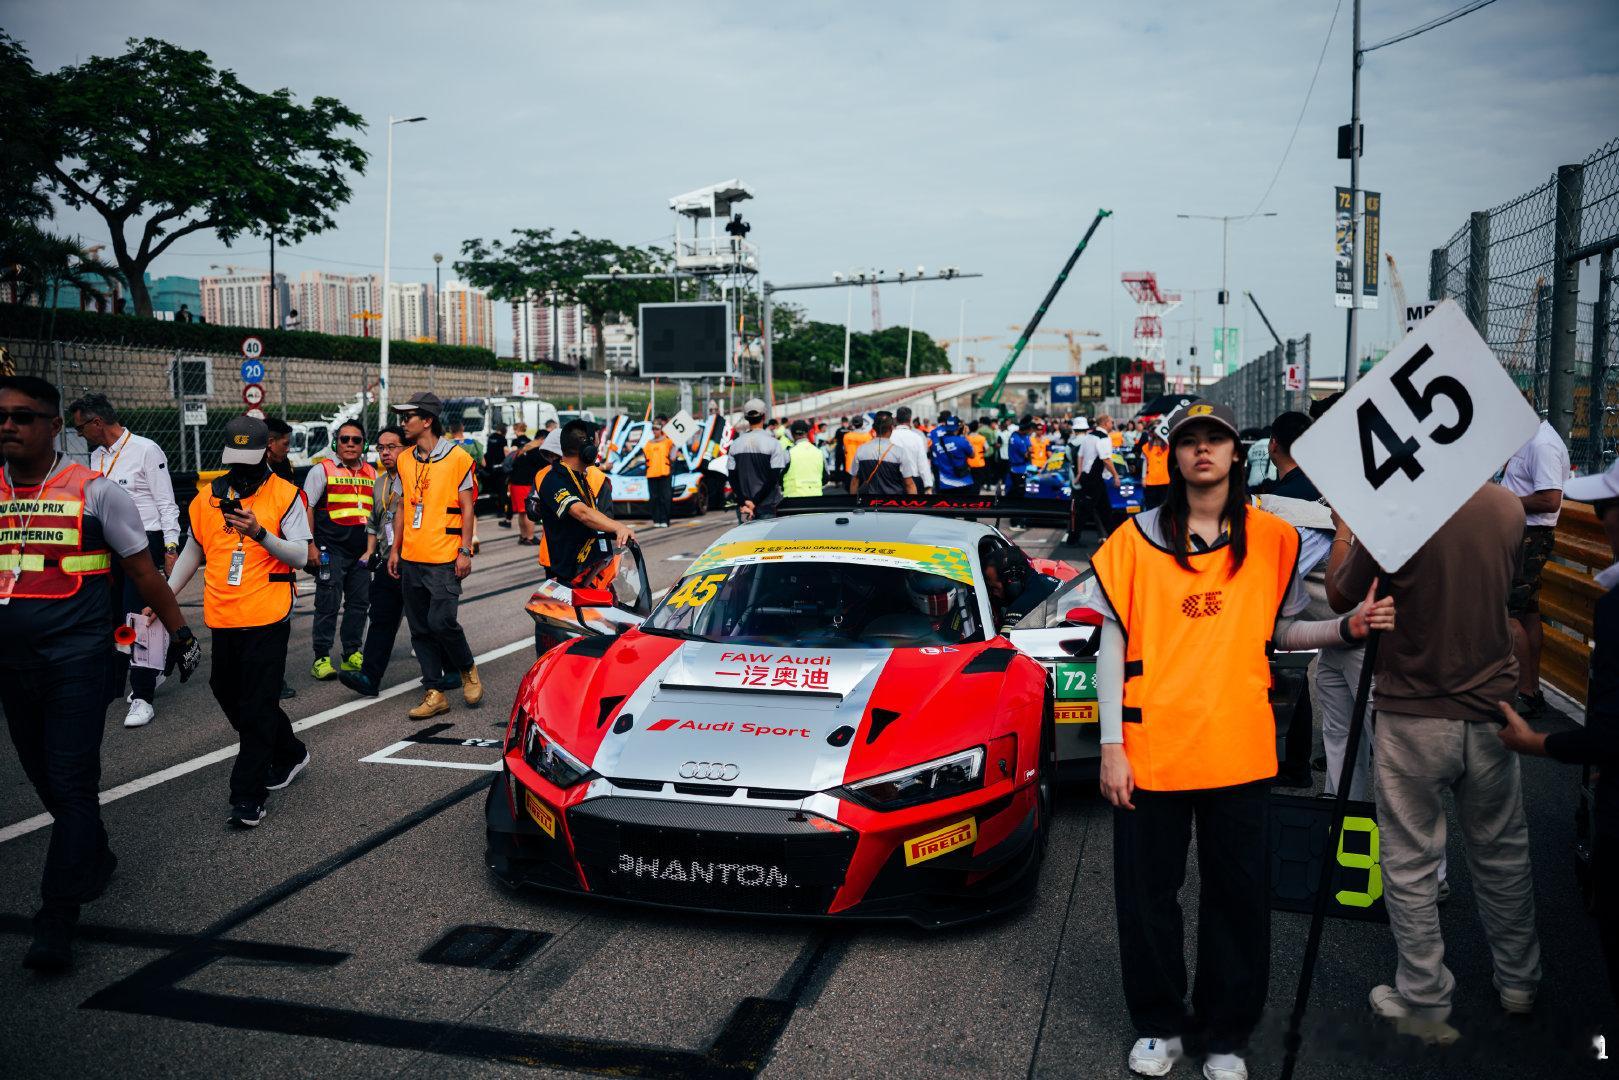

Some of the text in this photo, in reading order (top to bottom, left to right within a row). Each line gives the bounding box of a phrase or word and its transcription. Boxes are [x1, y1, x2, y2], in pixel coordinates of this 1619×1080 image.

[1339, 192, 1351, 208] 72
[246, 343, 259, 353] 40
[245, 365, 261, 378] 20
[1356, 343, 1474, 490] 45
[672, 419, 685, 433] 5
[42, 503, 64, 513] PRIX
[869, 499, 992, 508] FAW Audi
[666, 574, 728, 609] 45
[720, 652, 831, 666] FAW Audi
[715, 665, 829, 690] 一汽奥迪
[1062, 670, 1087, 691] 72
[678, 719, 811, 738] Audi Sport
[526, 794, 552, 831] PIRELLI
[911, 824, 971, 859] PIRELLI
